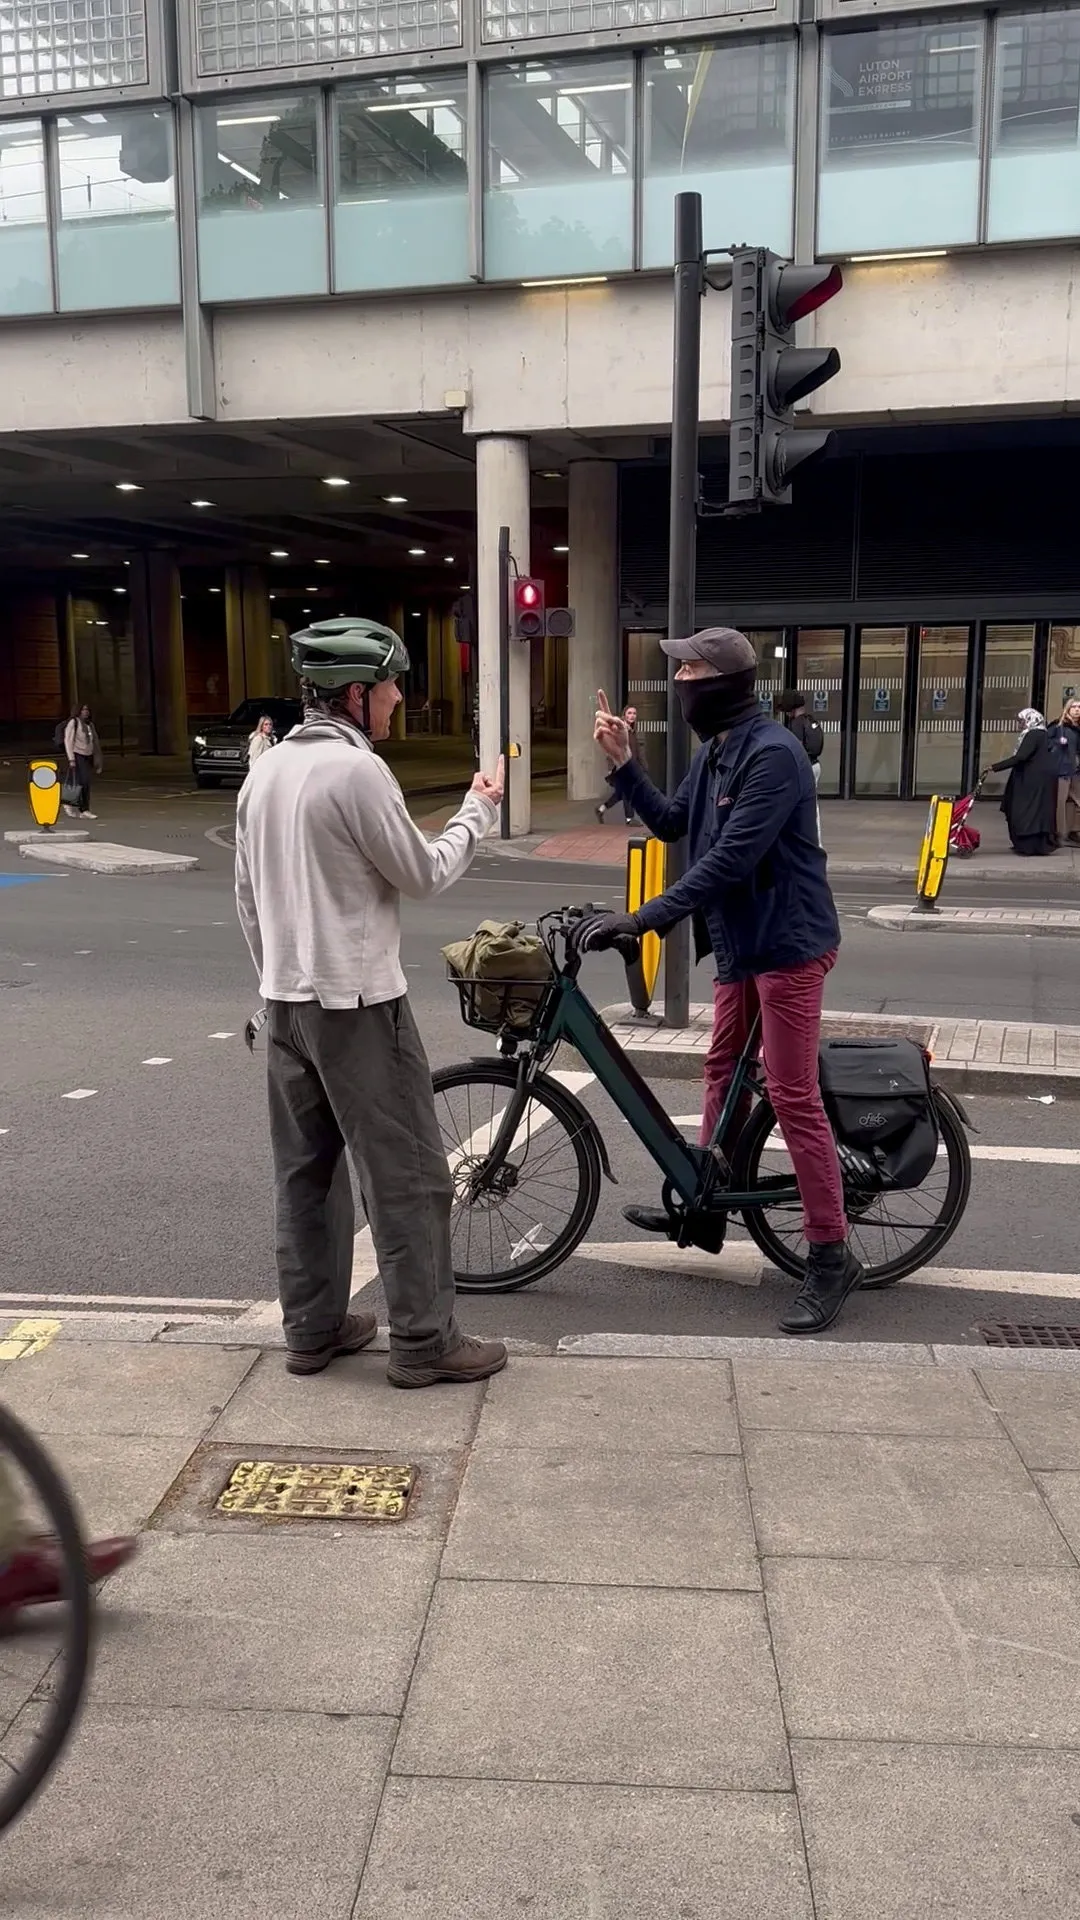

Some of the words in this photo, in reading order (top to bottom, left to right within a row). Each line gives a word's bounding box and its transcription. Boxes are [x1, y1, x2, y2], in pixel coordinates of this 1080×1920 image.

[859, 60, 899, 72] LUTON
[859, 70, 912, 83] AIRPORT
[858, 82, 911, 96] EXPRESS
